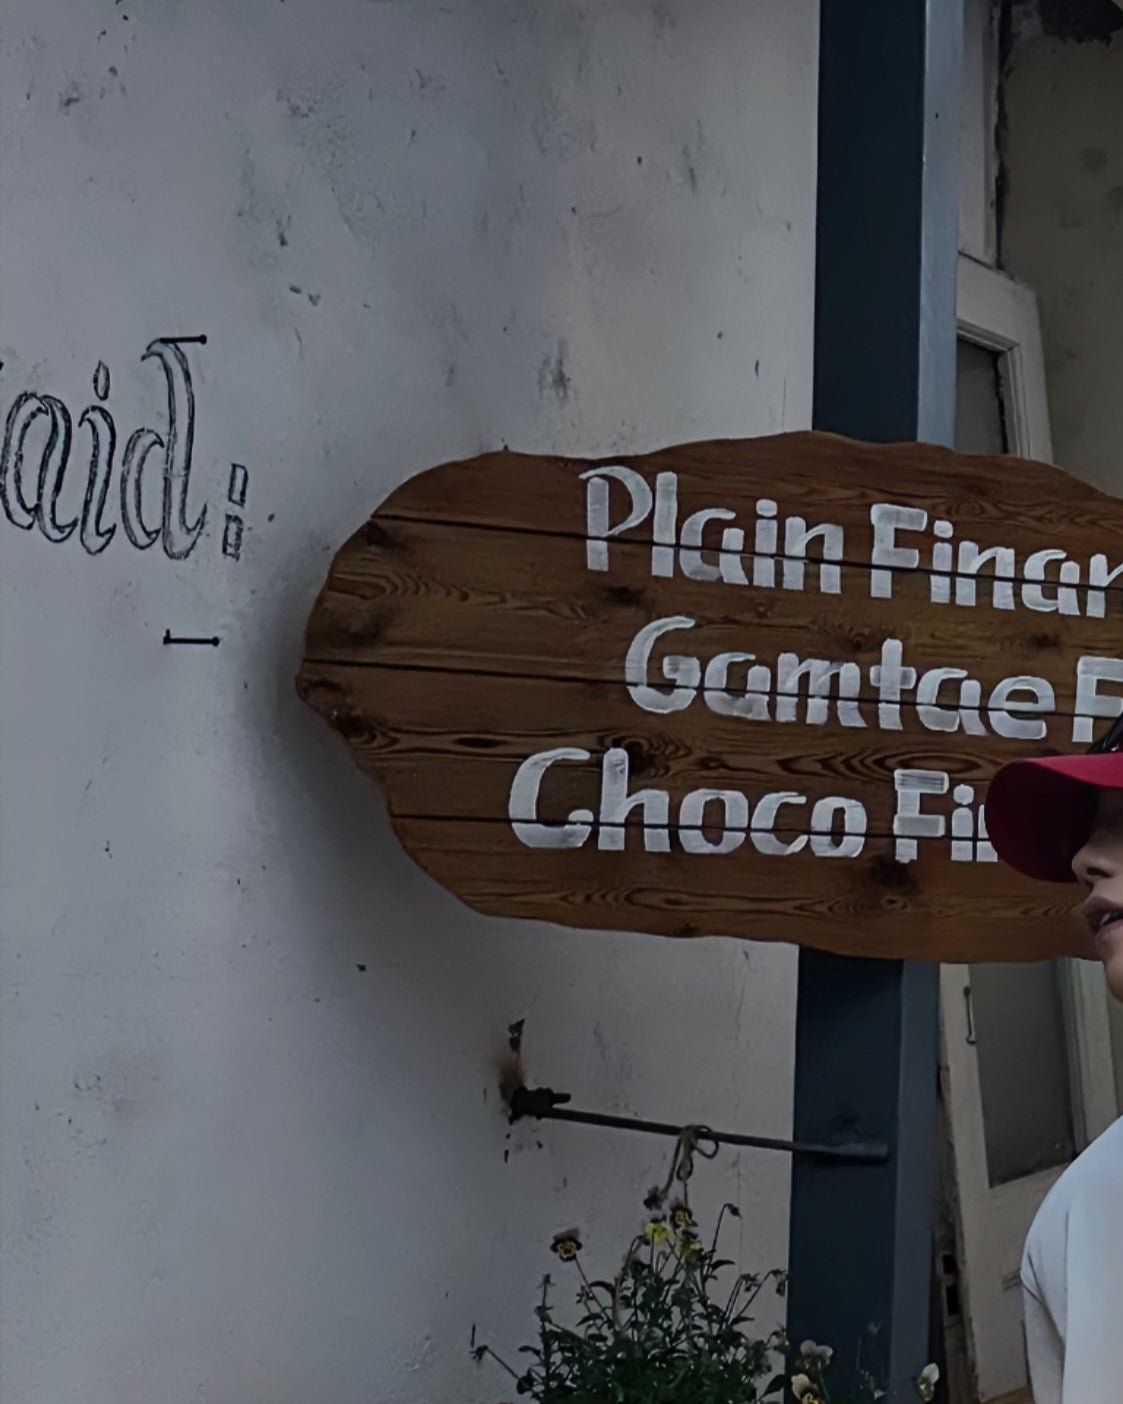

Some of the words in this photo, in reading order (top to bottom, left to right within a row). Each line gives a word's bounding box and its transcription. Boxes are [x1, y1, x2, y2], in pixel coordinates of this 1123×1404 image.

[579, 465, 844, 594] Plain
[625, 615, 1057, 740] Gamtae
[508, 746, 868, 859] Choco
